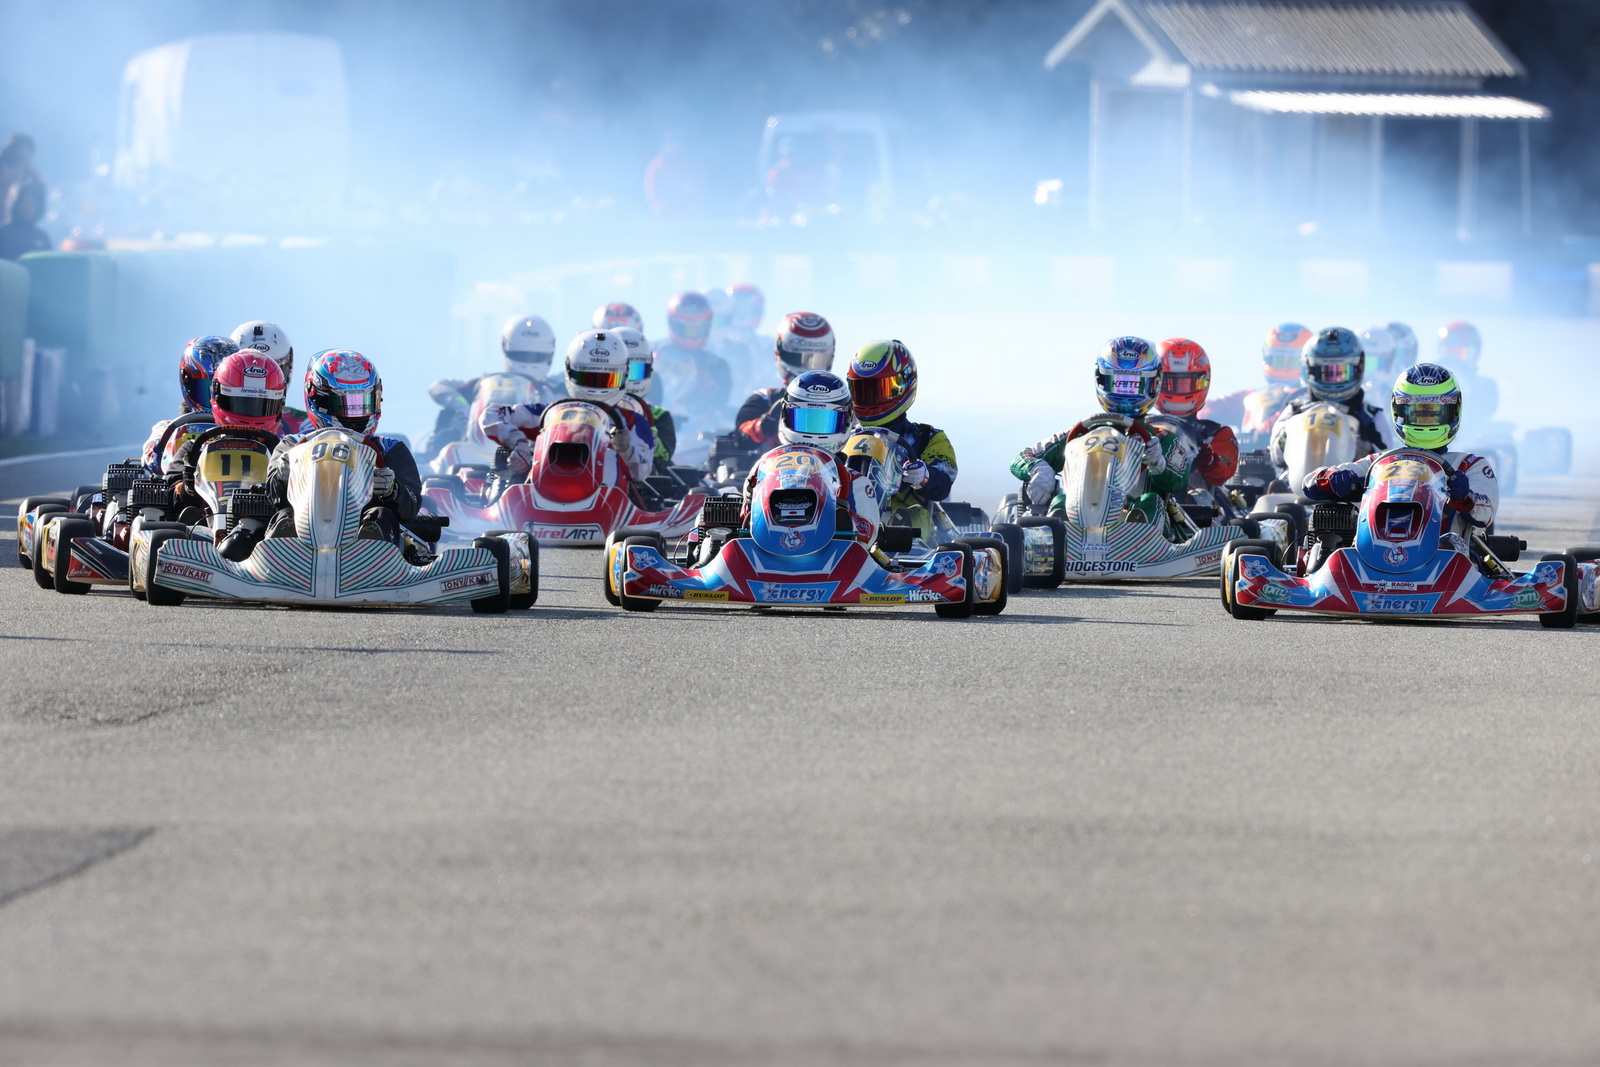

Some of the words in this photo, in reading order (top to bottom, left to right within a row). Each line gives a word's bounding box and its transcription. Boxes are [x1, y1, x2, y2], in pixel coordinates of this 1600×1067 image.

[244, 366, 266, 374] Arai
[1112, 380, 1141, 388] KAITO
[1415, 377, 1438, 385] Arai
[807, 385, 830, 393] Arai
[853, 438, 872, 453] 4
[1084, 436, 1119, 452] 98
[311, 442, 351, 461] 96
[221, 454, 251, 476] 11
[776, 455, 815, 468] 20
[164, 562, 185, 575] TONY
[188, 568, 211, 581] KART
[1065, 561, 1136, 572] RIDGESTONE
[442, 577, 463, 590] TONY
